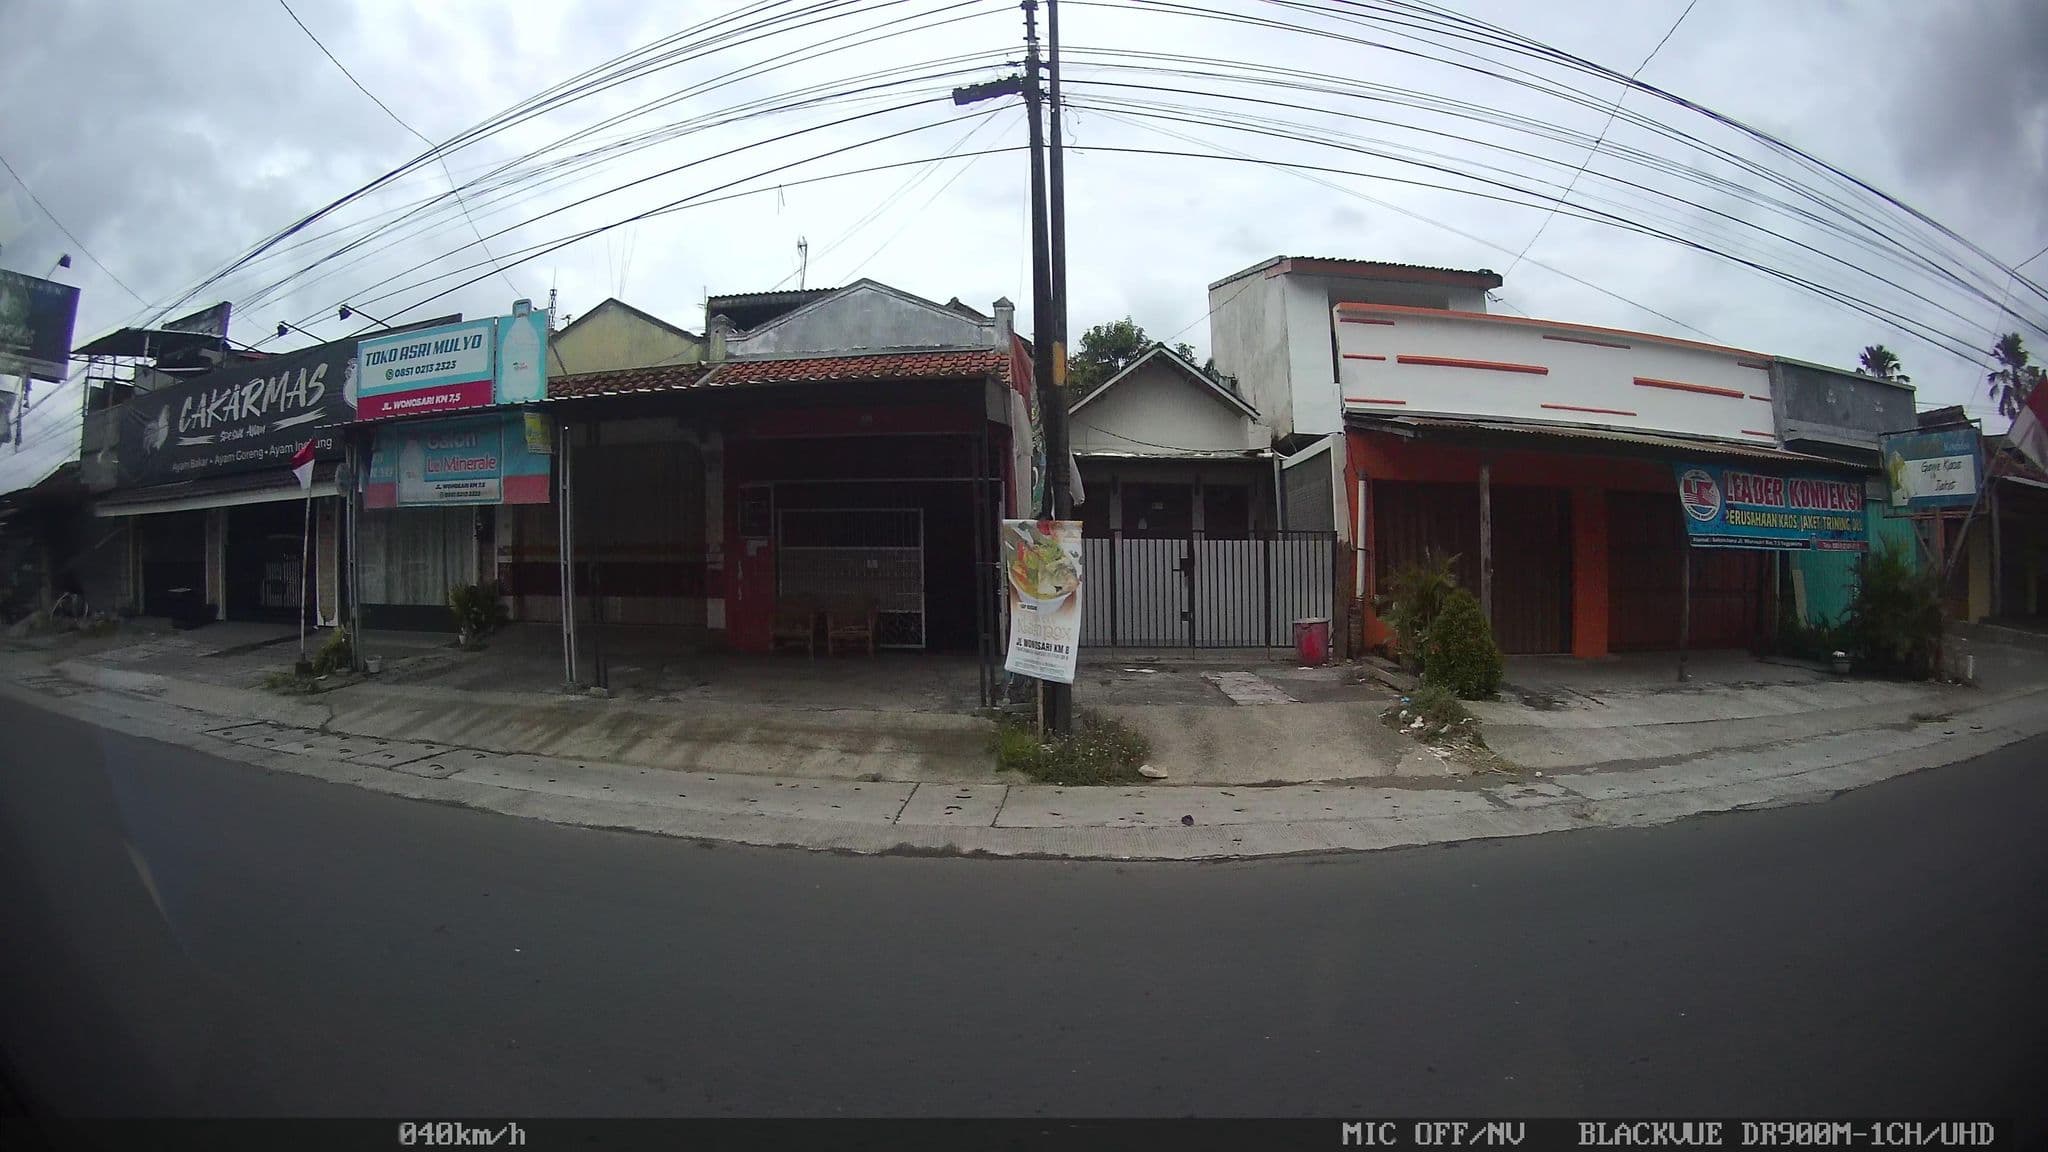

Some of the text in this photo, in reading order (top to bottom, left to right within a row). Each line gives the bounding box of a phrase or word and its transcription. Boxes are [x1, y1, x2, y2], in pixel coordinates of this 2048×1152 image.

[366, 335, 482, 367] TOKO ASRI MULYO
[436, 360, 458, 371] 2323
[178, 362, 329, 433] CAKARMAS
[393, 396, 434, 410] WONOSARI
[435, 394, 448, 405] KM
[215, 454, 236, 466] Ayam
[236, 448, 264, 462] Goreng
[269, 444, 294, 458] Ayam
[295, 438, 333, 452] Ingung
[443, 452, 496, 472] Minerale
[1723, 470, 1863, 512] LEADER KONVEKSI
[1726, 509, 1777, 528] PERUSAHAAN
